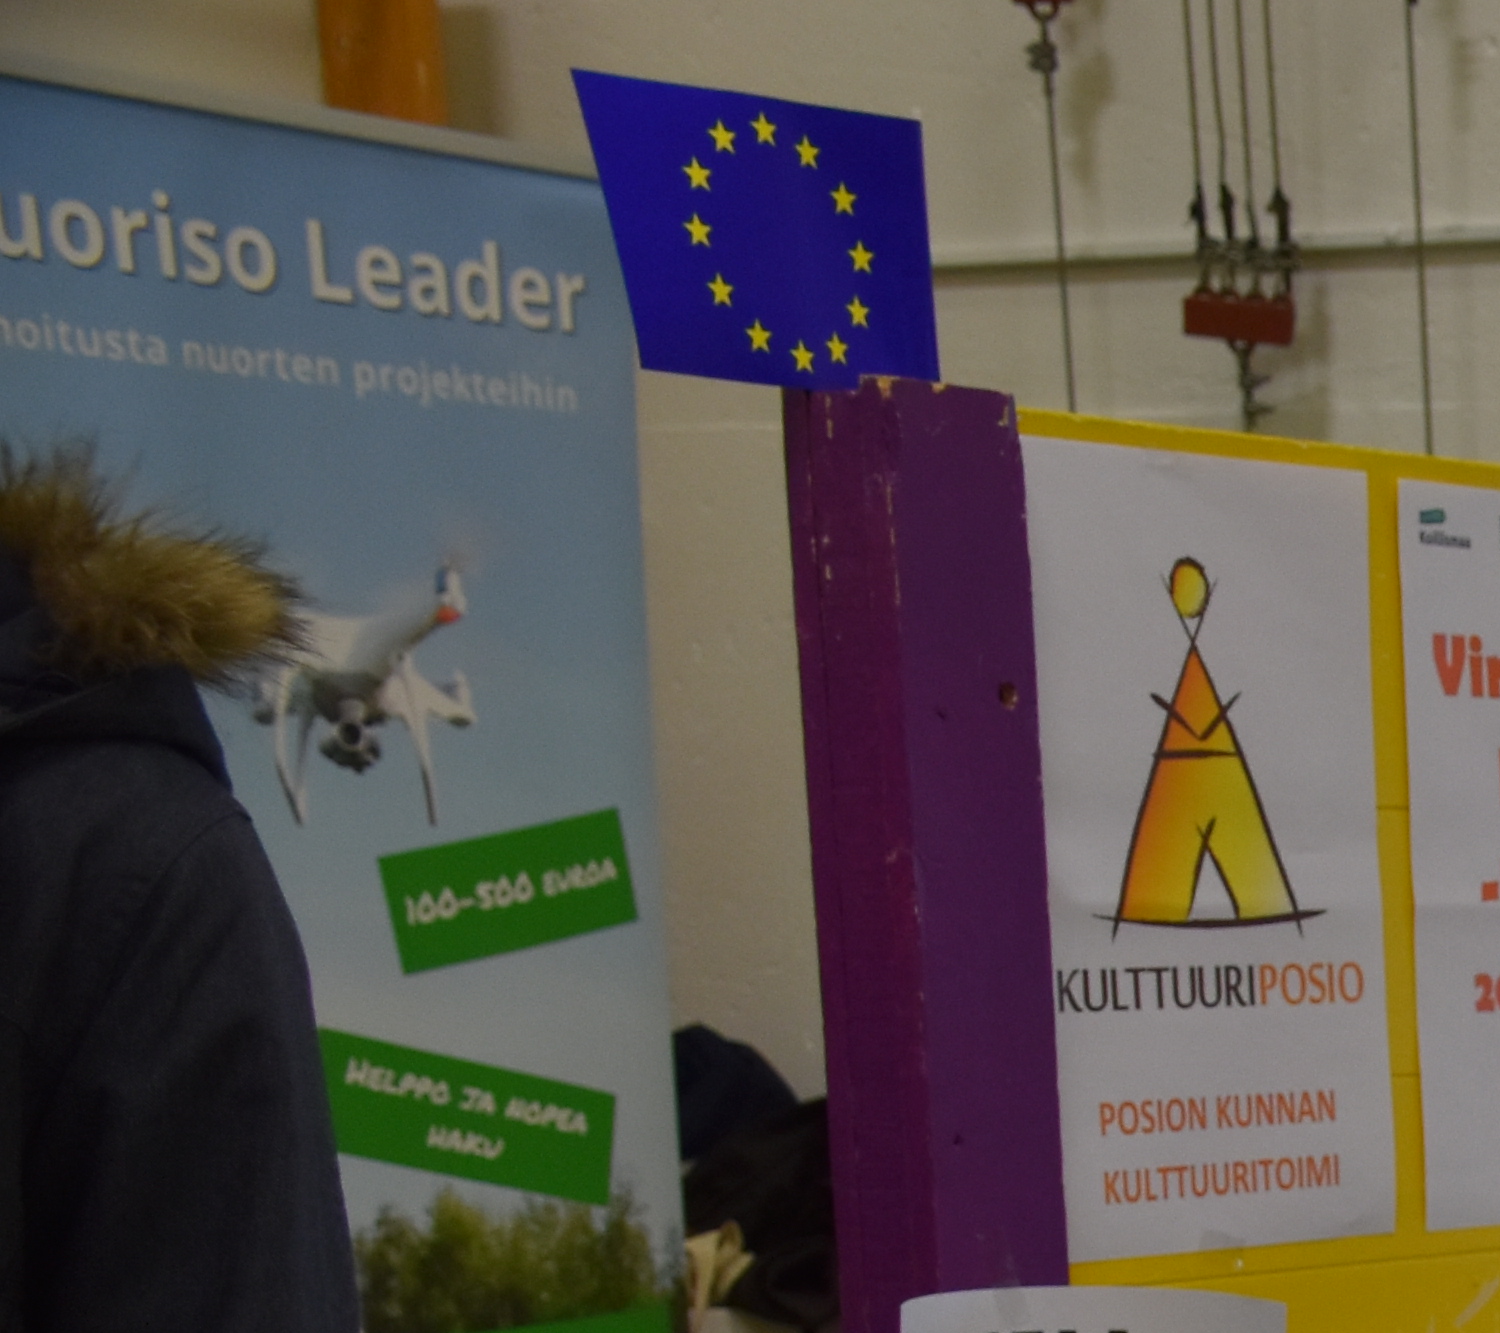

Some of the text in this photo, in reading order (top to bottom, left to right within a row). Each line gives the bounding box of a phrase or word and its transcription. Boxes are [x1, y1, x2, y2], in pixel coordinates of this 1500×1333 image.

[306, 219, 588, 334] Leader
[183, 341, 339, 385] nuorten
[354, 359, 578, 412] projekteihin
[1056, 962, 1365, 1014] KULTTUURIPOSIO
[345, 1056, 589, 1136] HELPPO JA NOPEA
[1098, 1089, 1338, 1137] POSION KUNNAN
[1103, 1153, 1342, 1206] KULTTUURITOIMI
